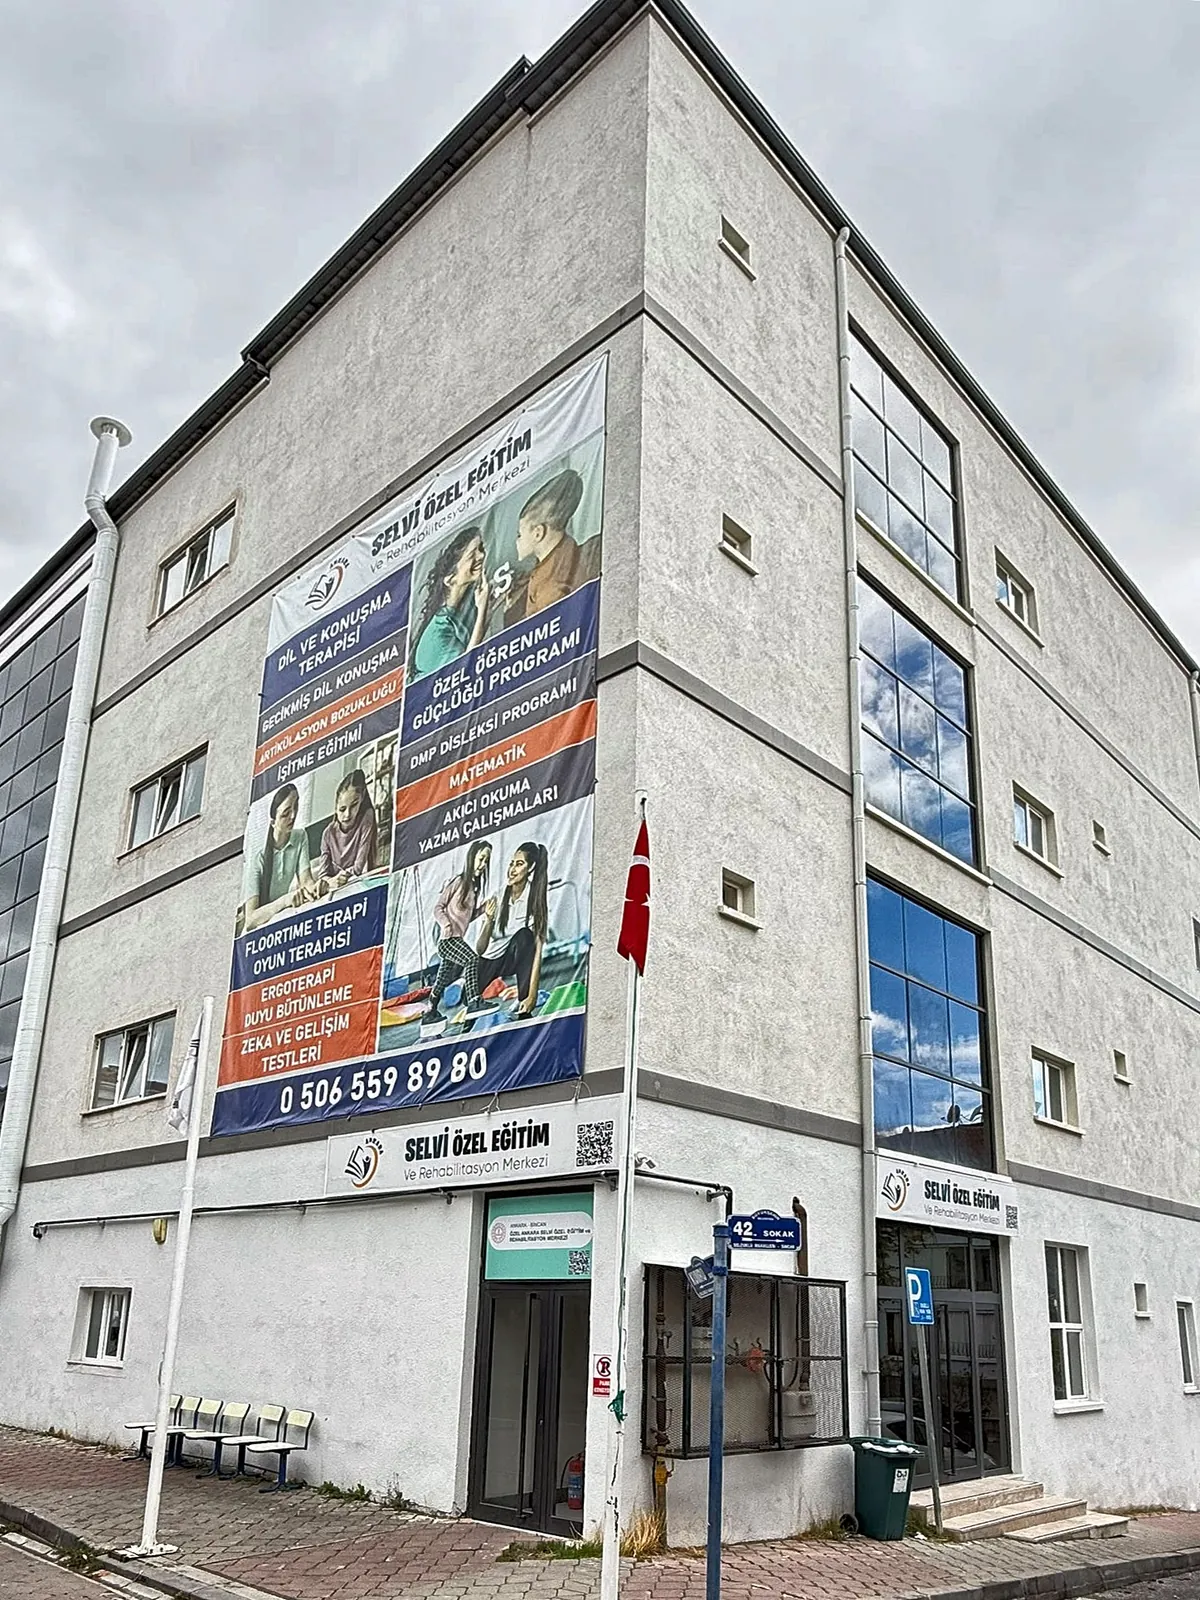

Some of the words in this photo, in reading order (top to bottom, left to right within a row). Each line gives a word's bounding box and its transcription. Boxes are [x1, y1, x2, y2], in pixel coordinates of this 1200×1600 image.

[370, 561, 383, 573] Ve
[387, 497, 474, 562] Rehabilitasyon
[479, 456, 530, 500] Merkezi
[372, 500, 421, 556] SELVİ
[424, 481, 462, 520] ÖZEL
[467, 428, 531, 491] EĞİTİM
[278, 648, 296, 671] DİL
[300, 635, 317, 655] VE
[320, 591, 391, 645] KONUŞMA
[299, 625, 360, 677] TERAPİSİ
[433, 667, 470, 698] ÖZEL
[475, 616, 561, 675] ÖĞRENME
[262, 694, 310, 733] GECİKMİŞ
[314, 682, 332, 701] DİL
[336, 645, 399, 688] KONUŞMA
[413, 678, 484, 730] GÜÇLÜĞÜ
[489, 628, 580, 691] PROGRAMI
[258, 718, 327, 765] ARTİKÜLASYON
[330, 680, 397, 724] BOZUKLUĞU
[410, 747, 436, 769] DMP
[440, 713, 498, 754] DİSLEKSİ
[502, 678, 577, 726] PROGRAMI
[278, 751, 314, 782] İŞİTME
[318, 724, 362, 760] EĞİTİMİ
[450, 743, 526, 789] MATEMATİK
[419, 827, 459, 853] YAZMA
[463, 785, 558, 838] ÇALIŞMALARI
[443, 800, 477, 825] AKICI
[481, 778, 530, 808] OKUMA
[245, 919, 312, 957] FLOORTIME
[316, 897, 368, 931] TERAPİ
[253, 953, 285, 975] OYUN
[289, 927, 351, 963] TERAPİSİ
[244, 1008, 273, 1028] DUYU
[276, 985, 353, 1018] BÜTÜNLEME
[261, 964, 335, 1002] ERGOTERAPİ
[241, 1032, 272, 1055] ZEKA
[276, 1027, 292, 1046] VE
[296, 1010, 349, 1042] GELİŞİM
[262, 1041, 321, 1072] TESTLERİ
[280, 1086, 293, 1114] 0
[300, 1076, 342, 1110] 506
[351, 1067, 398, 1101] 559
[407, 1058, 442, 1092] 89
[450, 1047, 487, 1083] 80
[405, 1127, 449, 1162] SELVİ
[452, 1129, 487, 1156] ÖZEL
[492, 1119, 549, 1151] EĞİTİM
[404, 1169, 416, 1180] Ve
[419, 1161, 499, 1179] Rehabilitasyon
[503, 1154, 548, 1171] Merkezi
[924, 1179, 950, 1202] SELVİ
[953, 1184, 971, 1206] ÖZEL
[973, 1188, 1000, 1211] EĞİTİM
[924, 1204, 932, 1215] Ve
[934, 1206, 978, 1222] Rehabilitasyon
[733, 1221, 757, 1236] 42.
